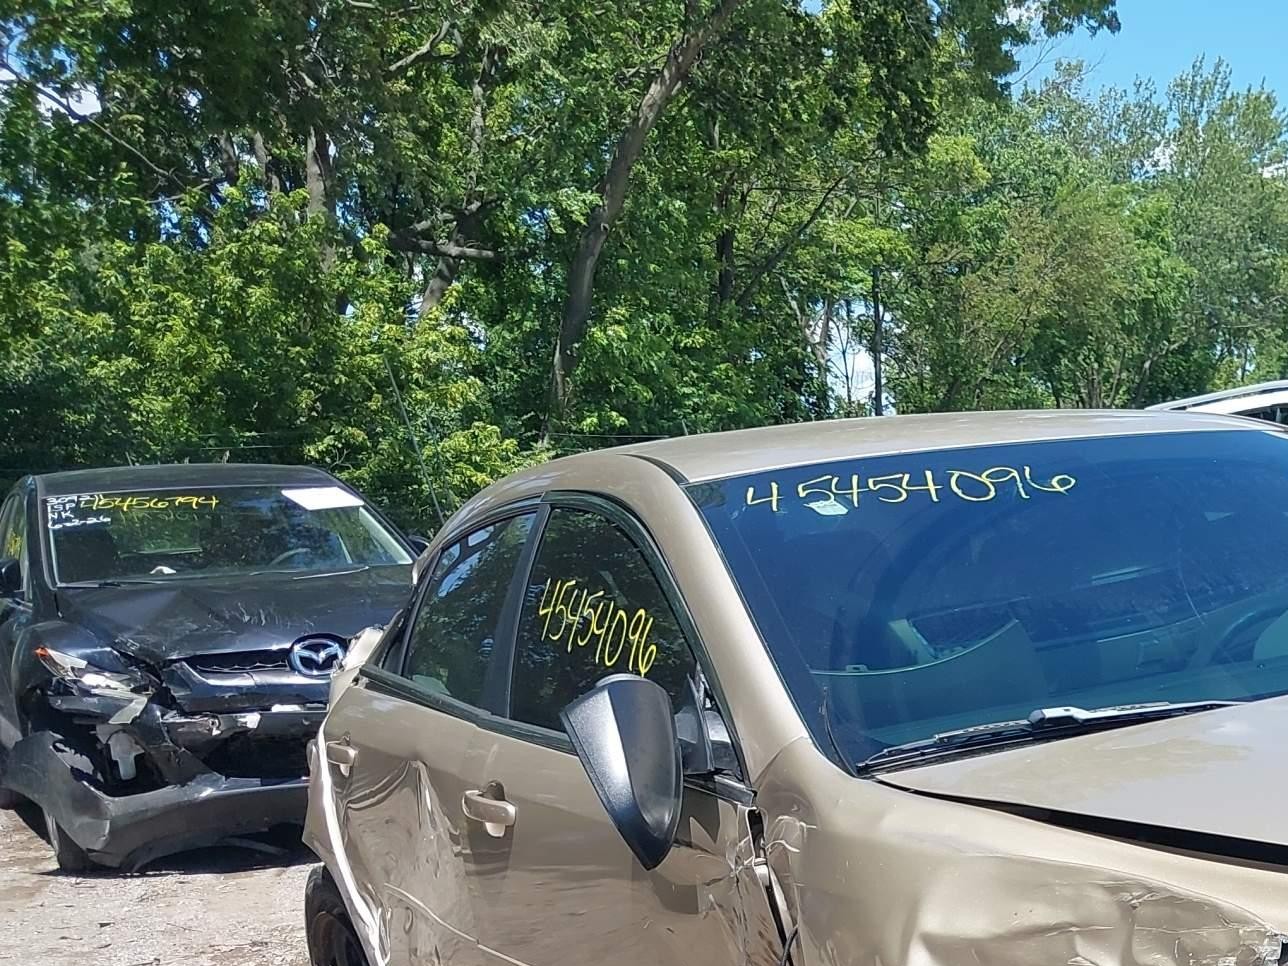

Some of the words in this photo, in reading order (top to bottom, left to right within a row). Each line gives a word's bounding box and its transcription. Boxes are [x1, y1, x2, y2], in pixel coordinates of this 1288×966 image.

[80, 494, 219, 512] 45456794
[746, 465, 1077, 512] 45454096
[538, 577, 657, 678] 45454096
